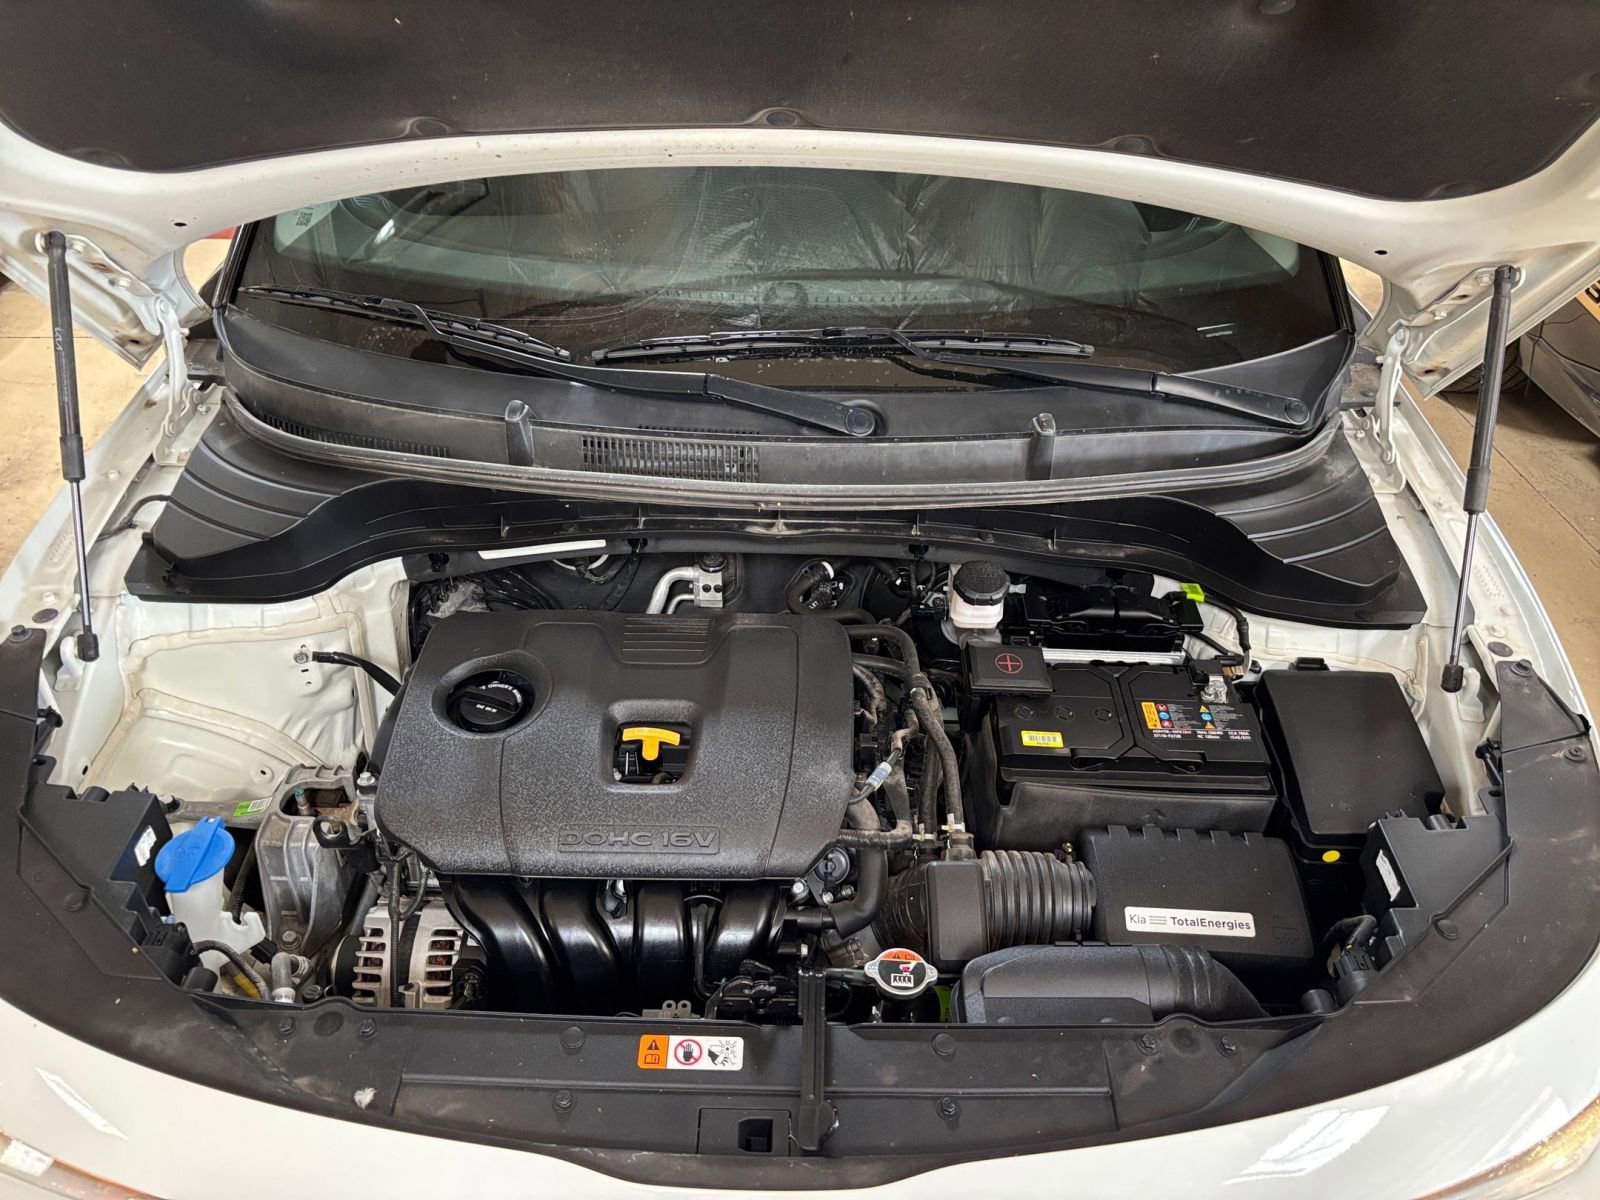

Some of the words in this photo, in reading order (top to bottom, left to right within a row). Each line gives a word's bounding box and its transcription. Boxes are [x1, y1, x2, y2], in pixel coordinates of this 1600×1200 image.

[559, 831, 653, 846] DOHC
[662, 832, 717, 848] 16V
[1129, 914, 1147, 925] Kia
[1170, 916, 1251, 931] TotalEnergies
